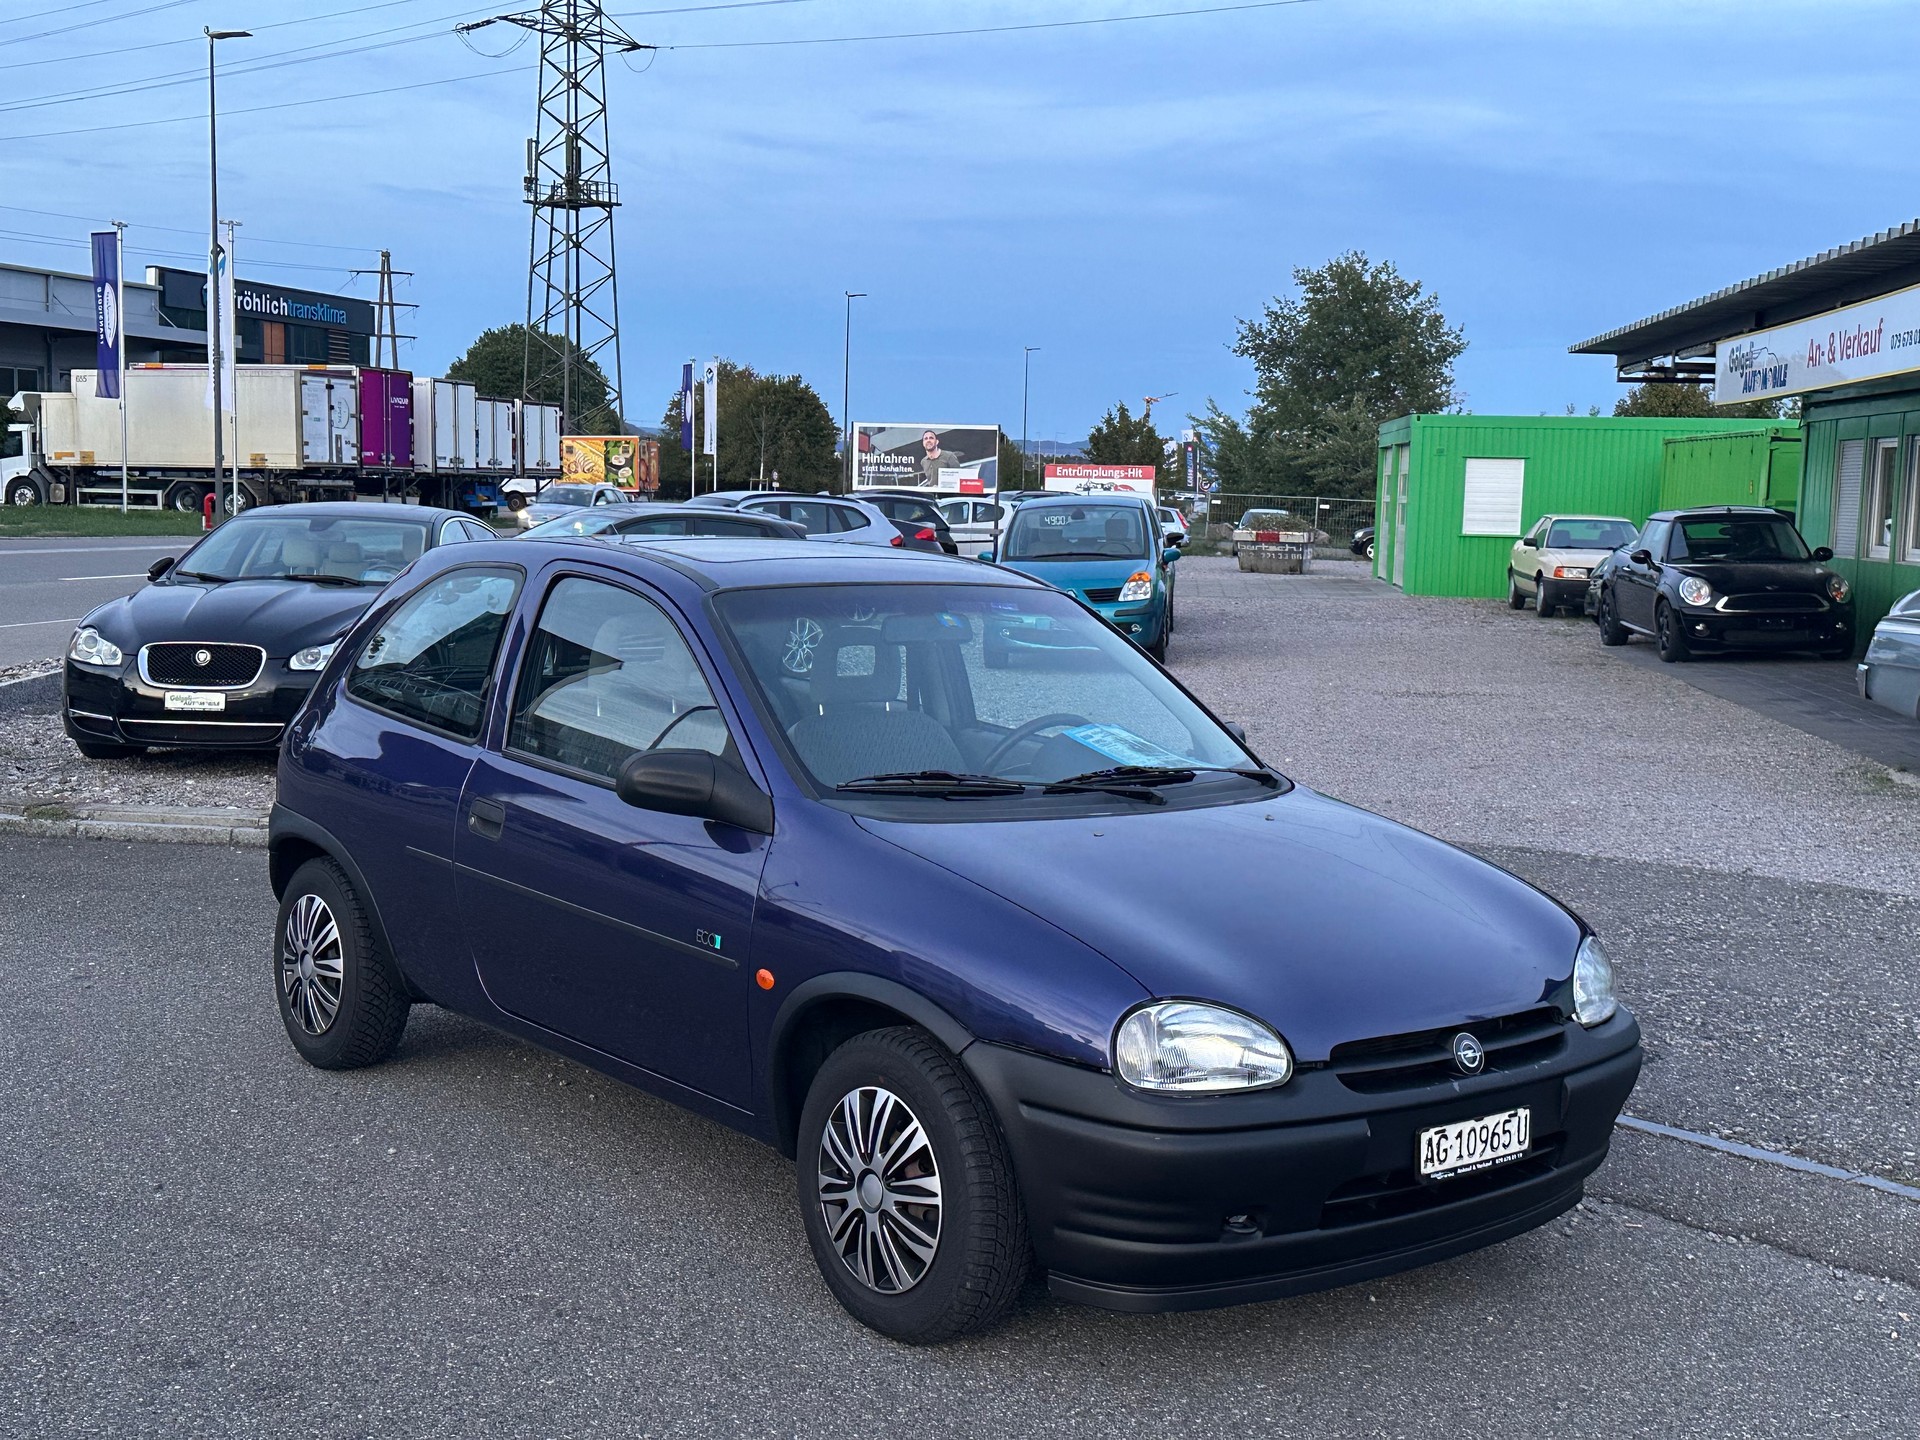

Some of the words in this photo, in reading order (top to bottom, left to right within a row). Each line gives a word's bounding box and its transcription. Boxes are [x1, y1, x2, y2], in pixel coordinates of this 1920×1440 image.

[1807, 338, 1825, 368] An-
[1827, 332, 1836, 364] &
[1839, 317, 1884, 361] Verkauf
[862, 452, 915, 464] Hinfahren
[1056, 466, 1143, 479] Entrümplungs-Hit
[696, 929, 715, 947] ECO
